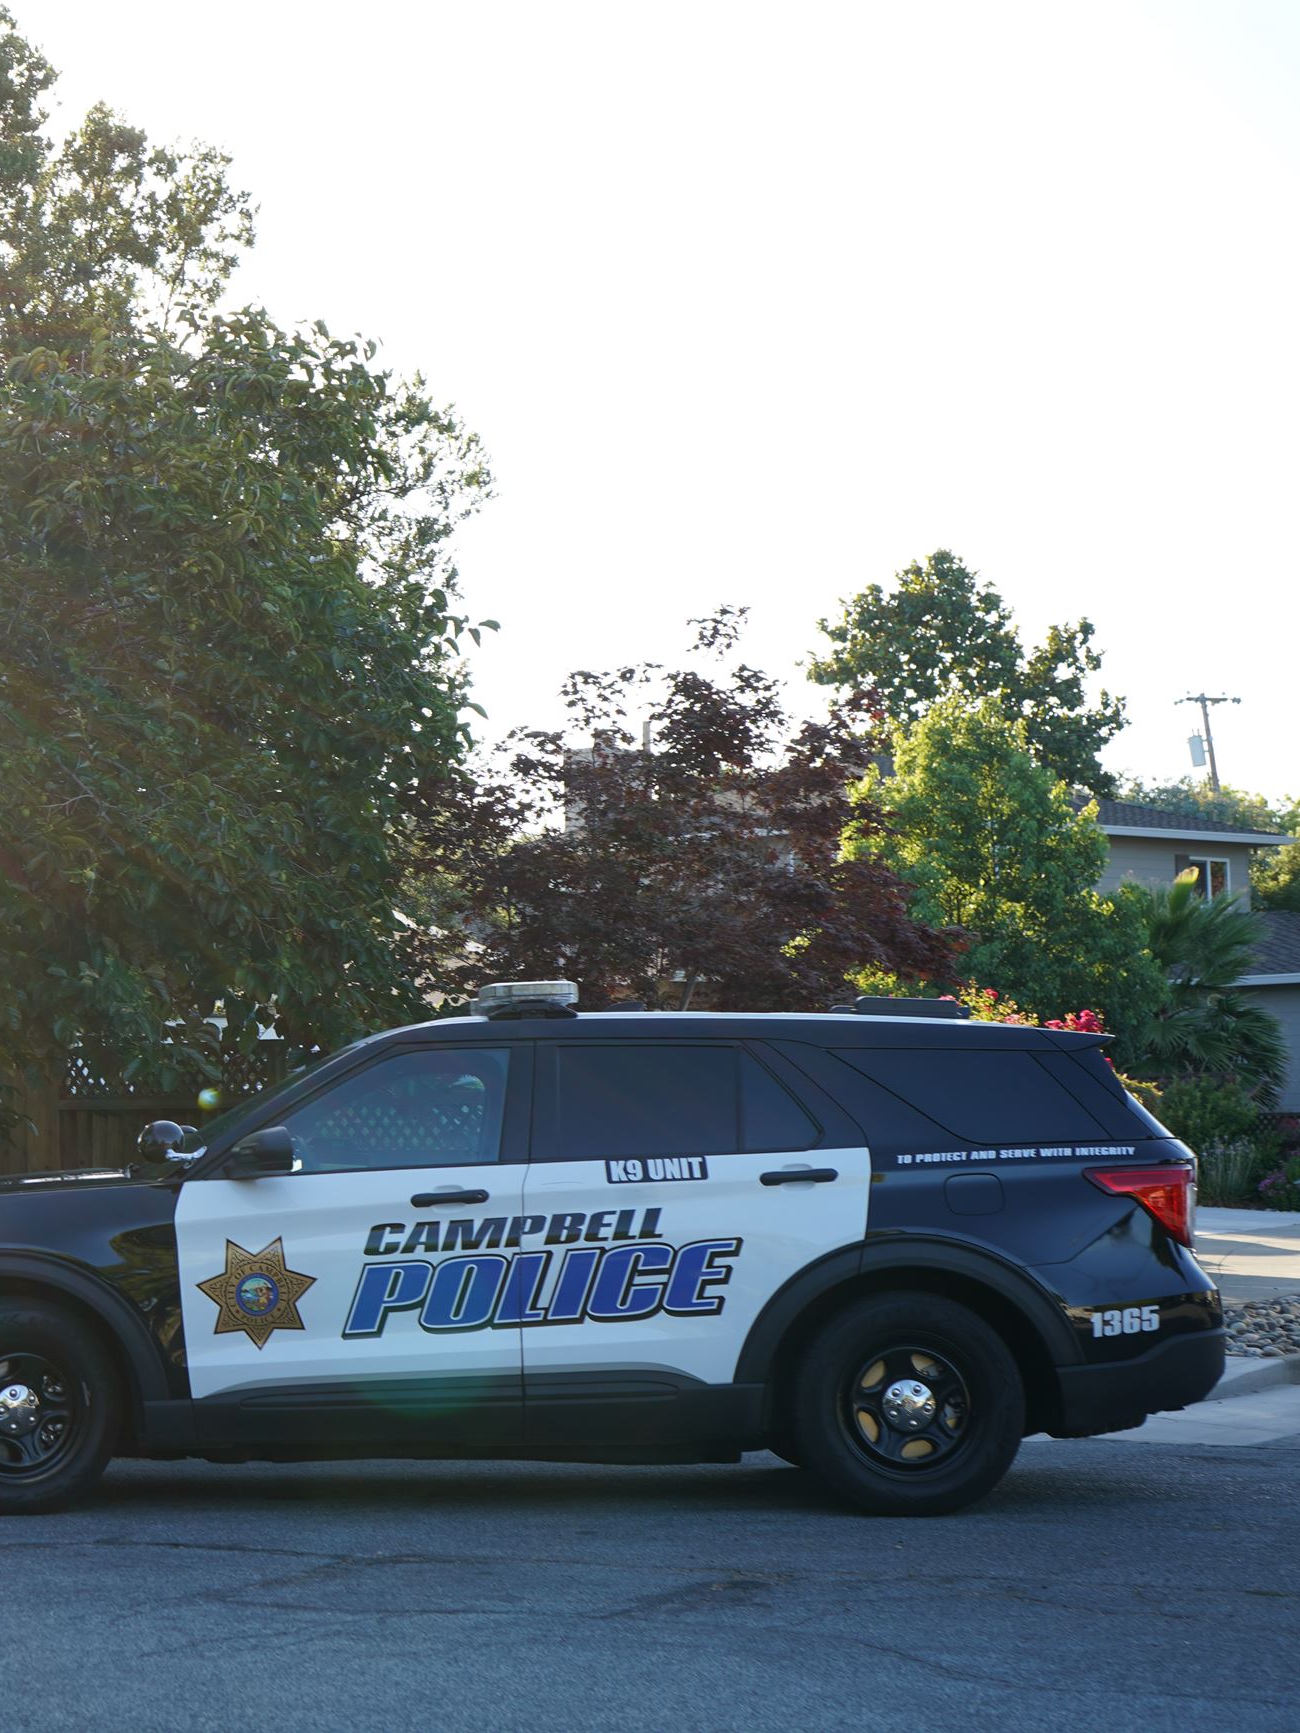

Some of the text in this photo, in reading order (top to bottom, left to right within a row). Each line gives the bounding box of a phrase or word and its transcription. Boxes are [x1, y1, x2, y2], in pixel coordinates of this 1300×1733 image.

[609, 1157, 703, 1182] K9 UNIT
[897, 1146, 1135, 1164] TO PROTECT AND SERVE WITH INTEGRITY
[363, 1207, 663, 1256] CAMPBELL
[342, 1237, 744, 1340] POLICE
[1090, 1305, 1160, 1338] 1365
